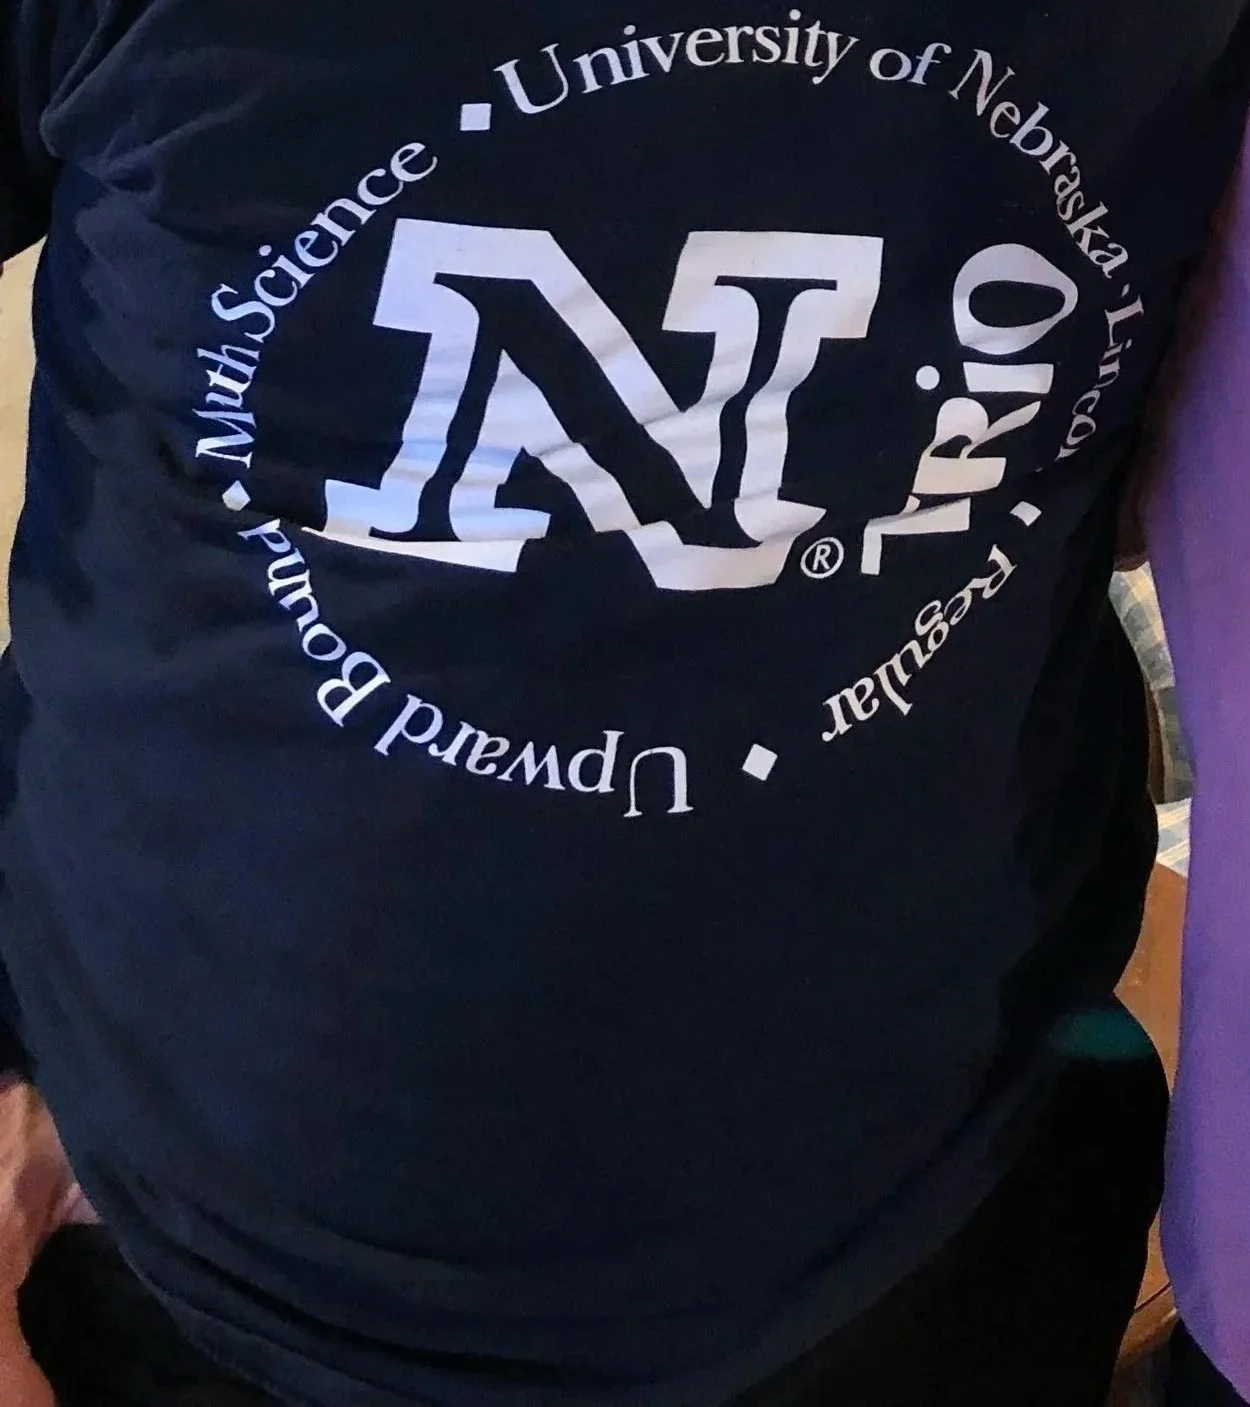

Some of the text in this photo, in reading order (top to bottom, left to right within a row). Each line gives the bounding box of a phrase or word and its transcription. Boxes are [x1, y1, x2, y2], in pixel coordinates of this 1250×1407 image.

[493, 8, 859, 115] University
[869, 42, 952, 85] of
[300, 217, 884, 592] N
[237, 518, 694, 818] Upward Bound
[821, 543, 1018, 742] Regular
